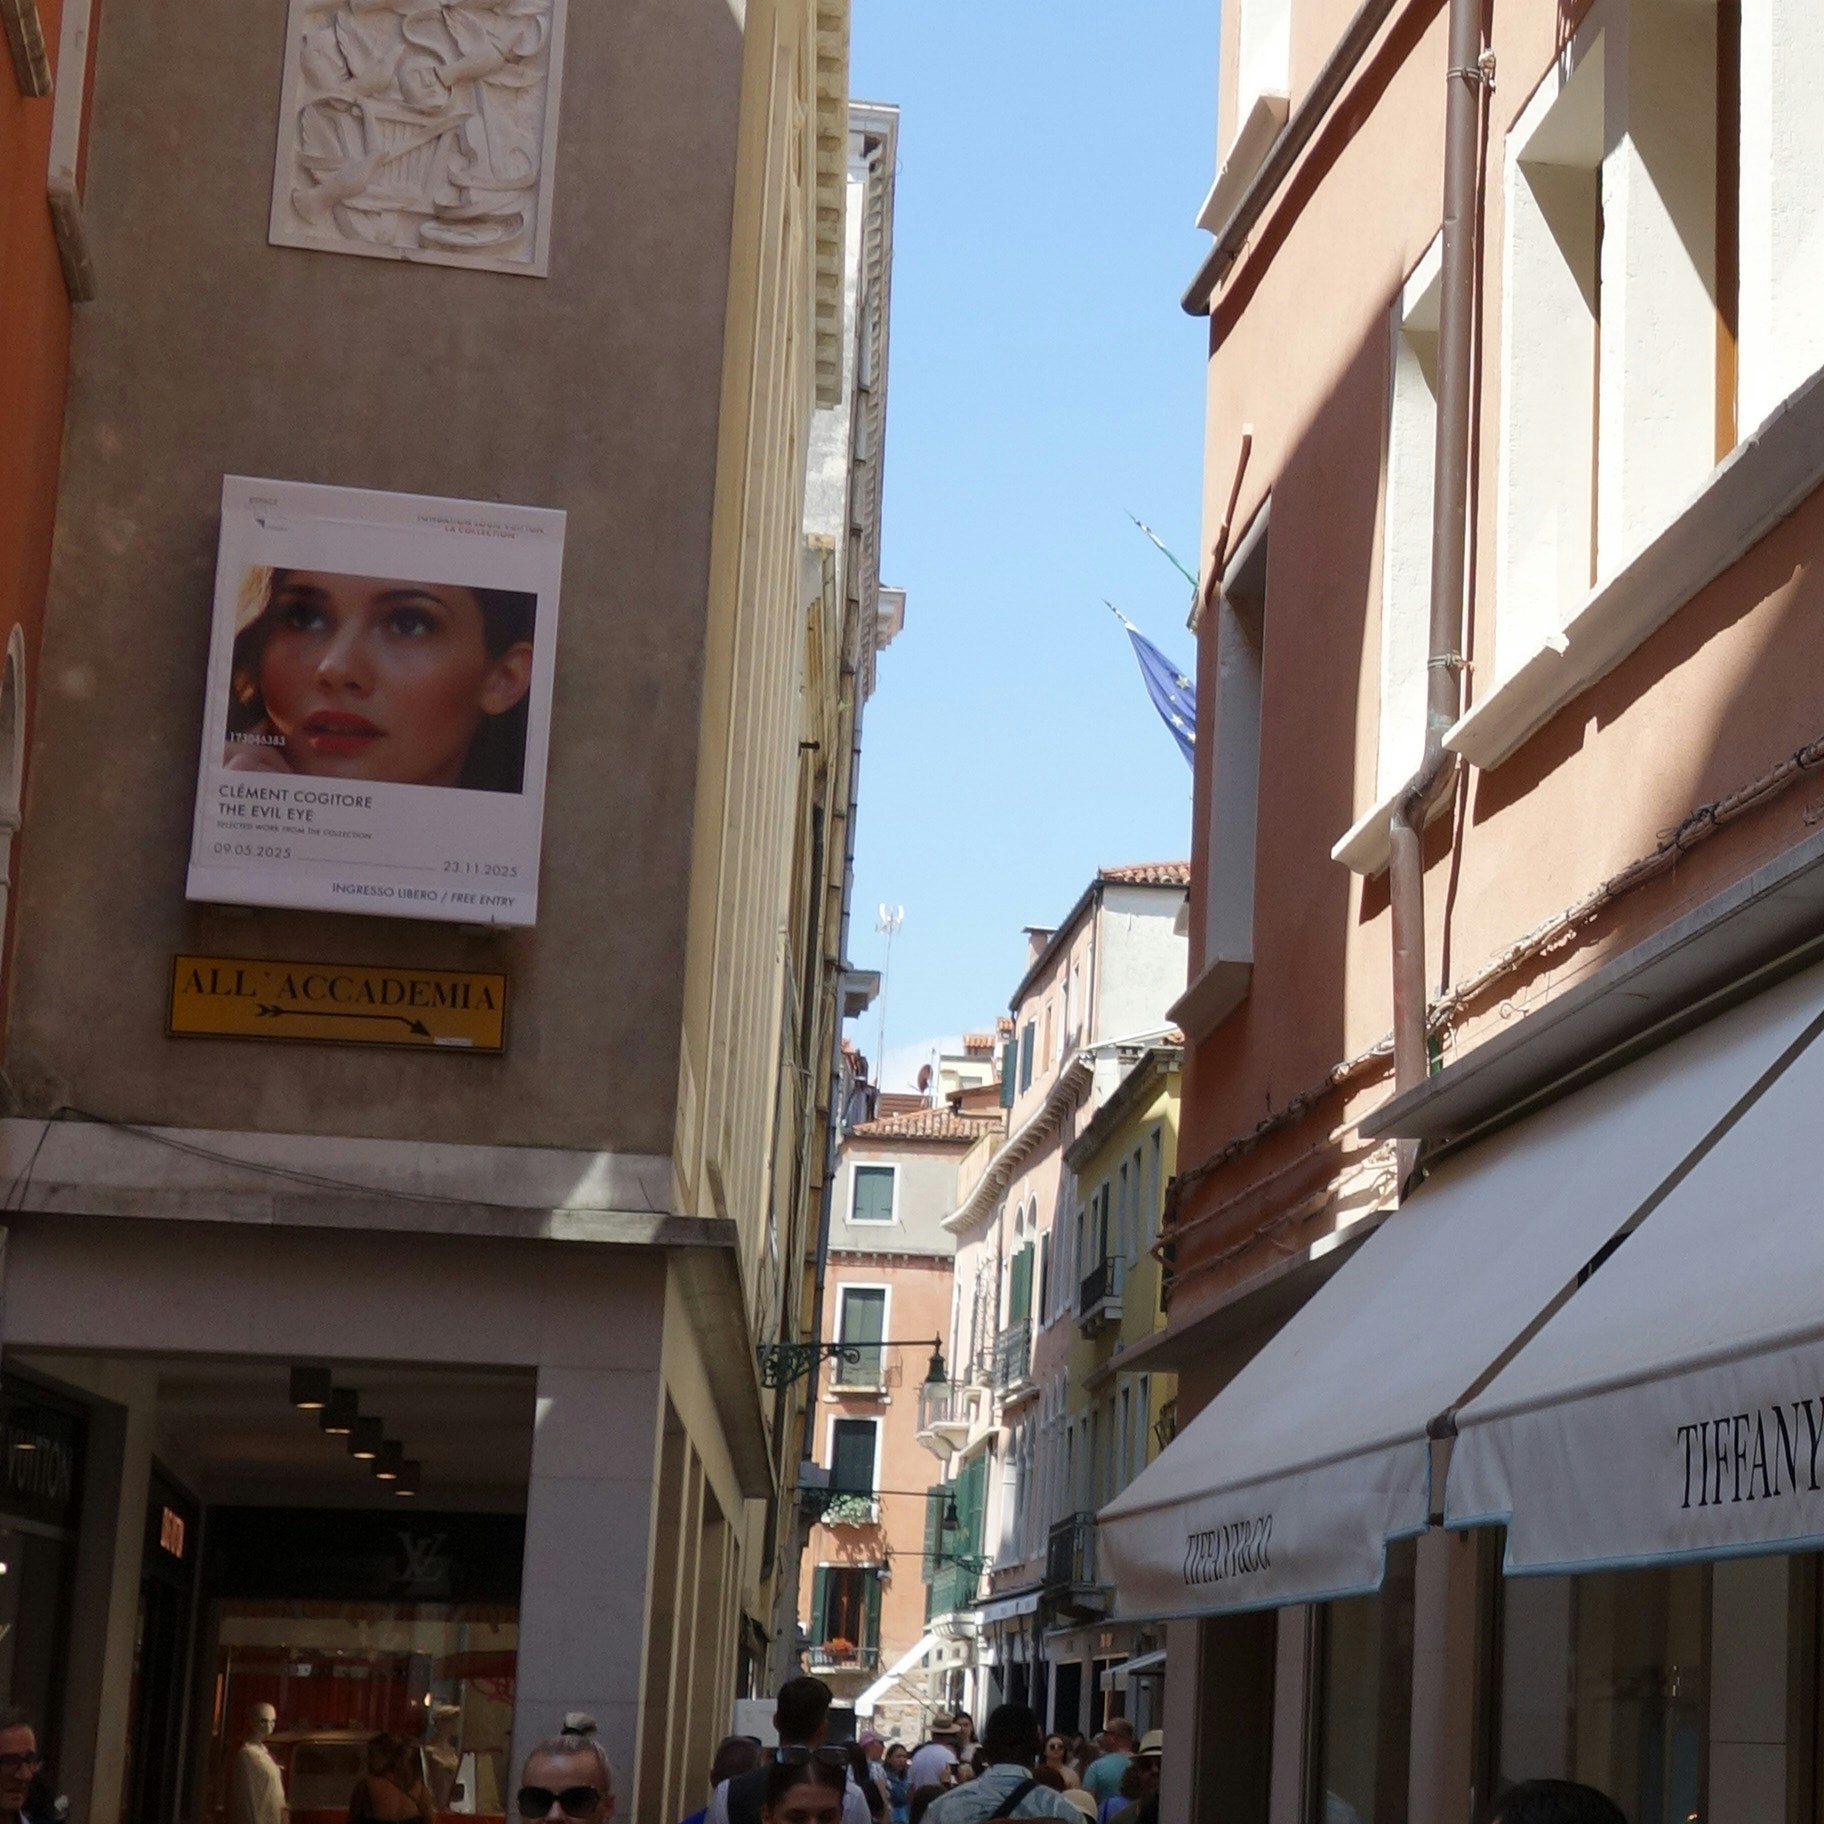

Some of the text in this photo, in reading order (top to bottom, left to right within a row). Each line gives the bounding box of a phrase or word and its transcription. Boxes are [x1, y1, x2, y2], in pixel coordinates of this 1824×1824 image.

[218, 782, 373, 809] CLÉMENT COGITORE
[218, 802, 314, 822] THE EVIL EYE
[255, 823, 279, 832] WORK
[282, 825, 305, 834] FROM
[308, 828, 320, 836] THE
[323, 829, 372, 840] COLLECTION
[213, 842, 291, 859] 09.05.2025
[443, 861, 518, 877] 23.11.2025
[332, 882, 394, 898] INGRESSO
[398, 888, 437, 902] LIBERO
[451, 892, 476, 905] FREE
[479, 895, 515, 907] ENTRY
